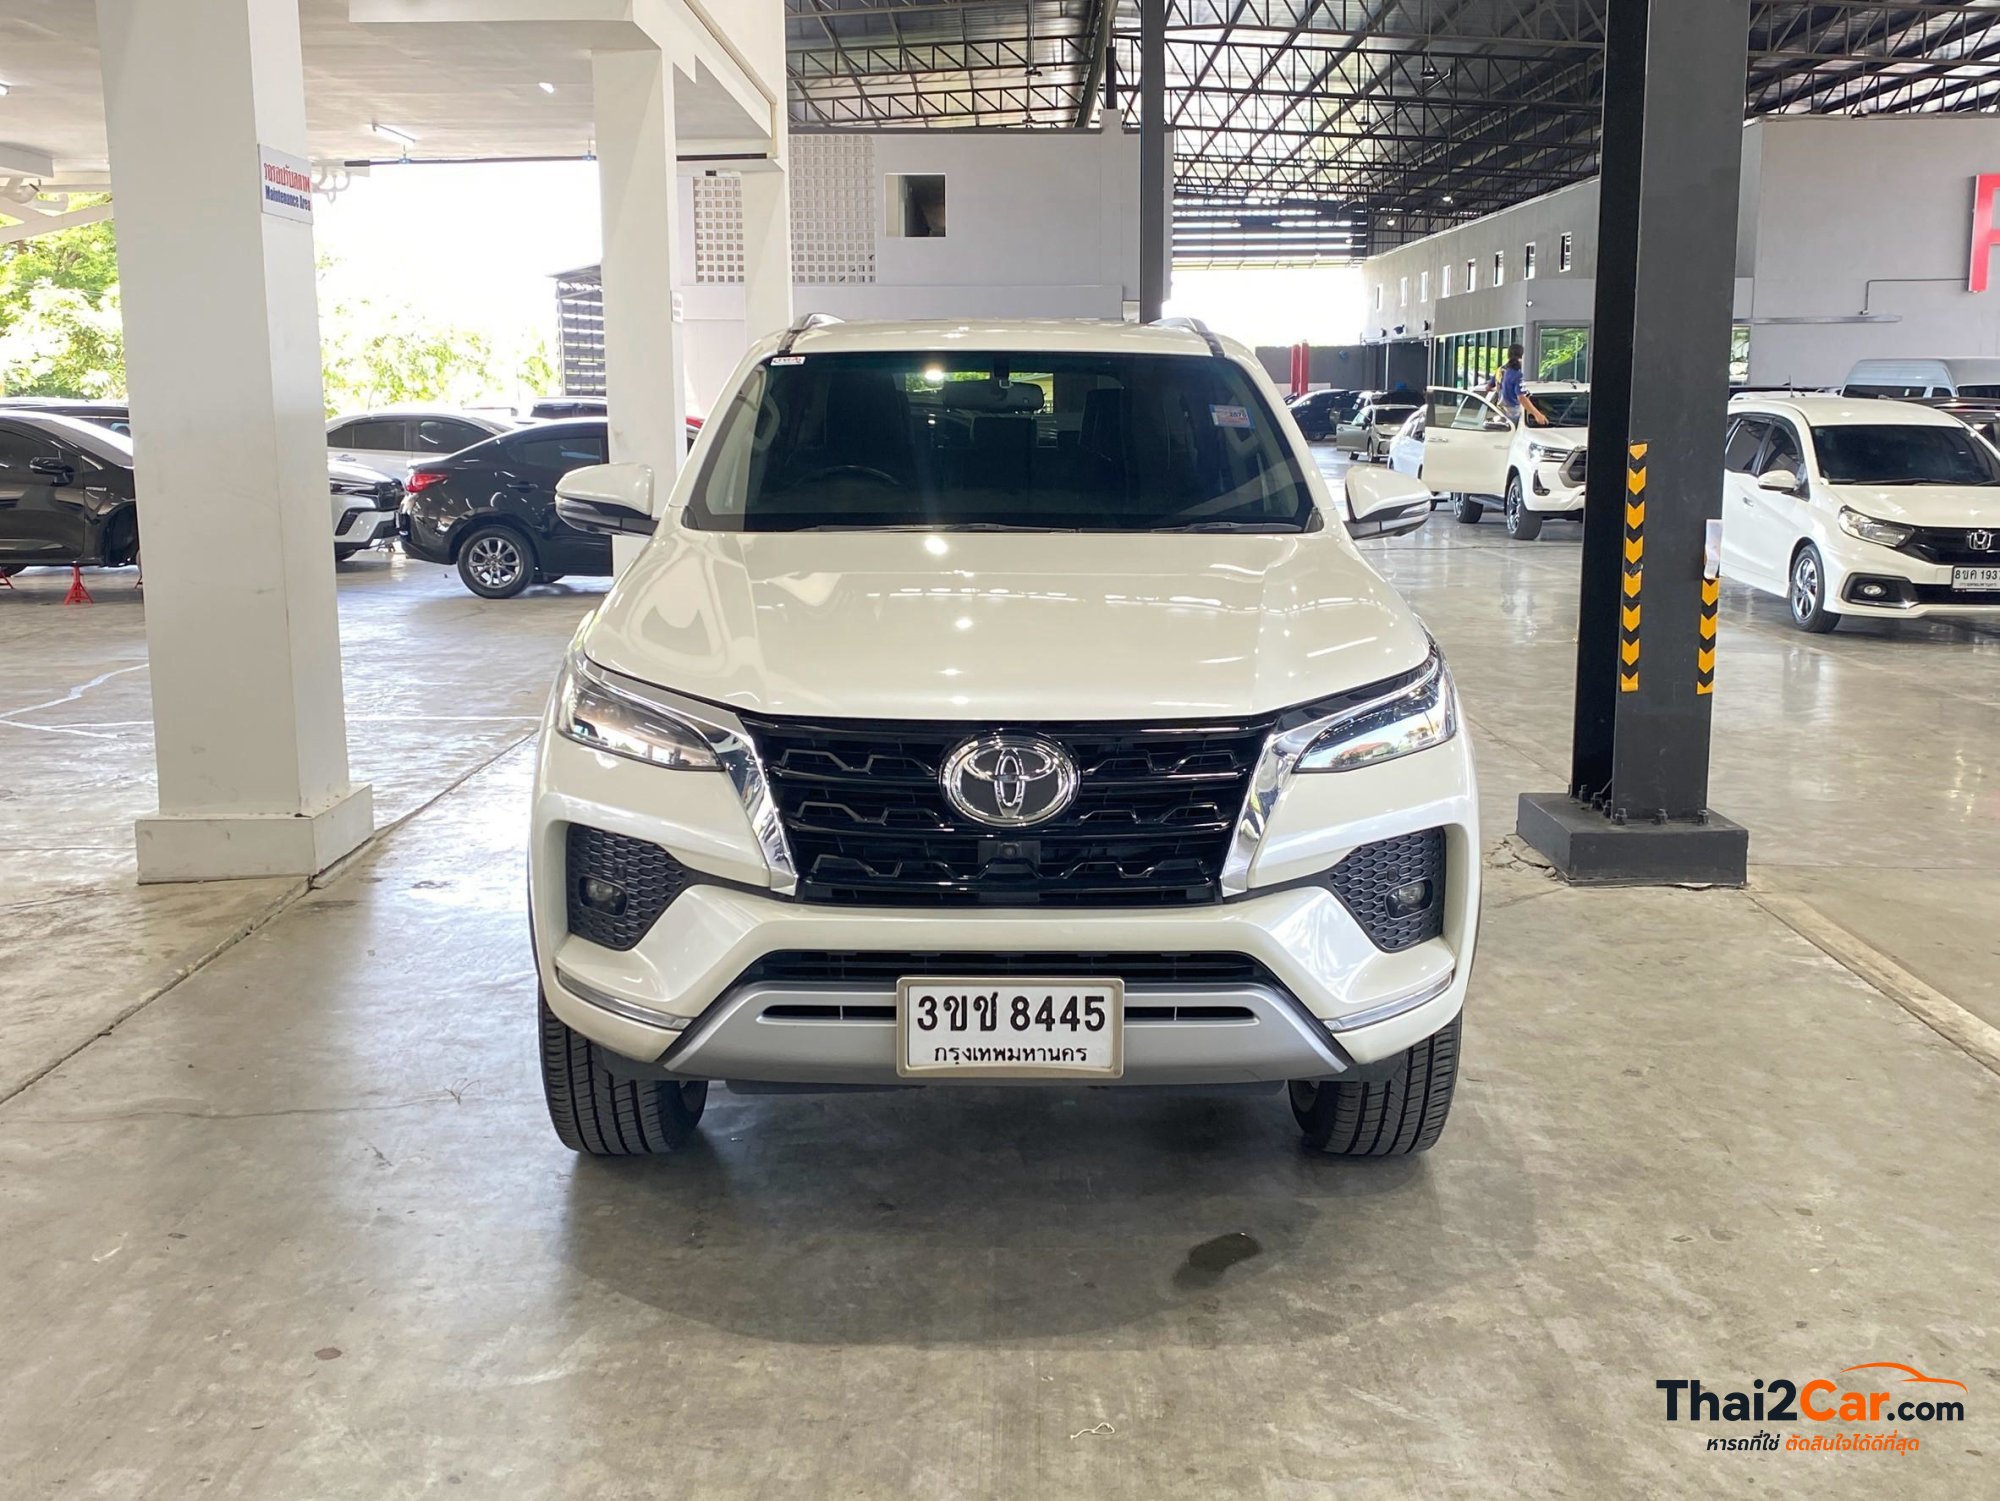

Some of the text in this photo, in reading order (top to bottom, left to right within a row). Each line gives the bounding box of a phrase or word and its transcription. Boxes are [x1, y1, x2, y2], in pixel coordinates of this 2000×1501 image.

[265, 185, 311, 211] Maintenance Area
[1981, 570, 2000, 580] 193
[917, 991, 1106, 1032] 3ขช 8445
[934, 1046, 1088, 1065] กรุงเทพมหานคร
